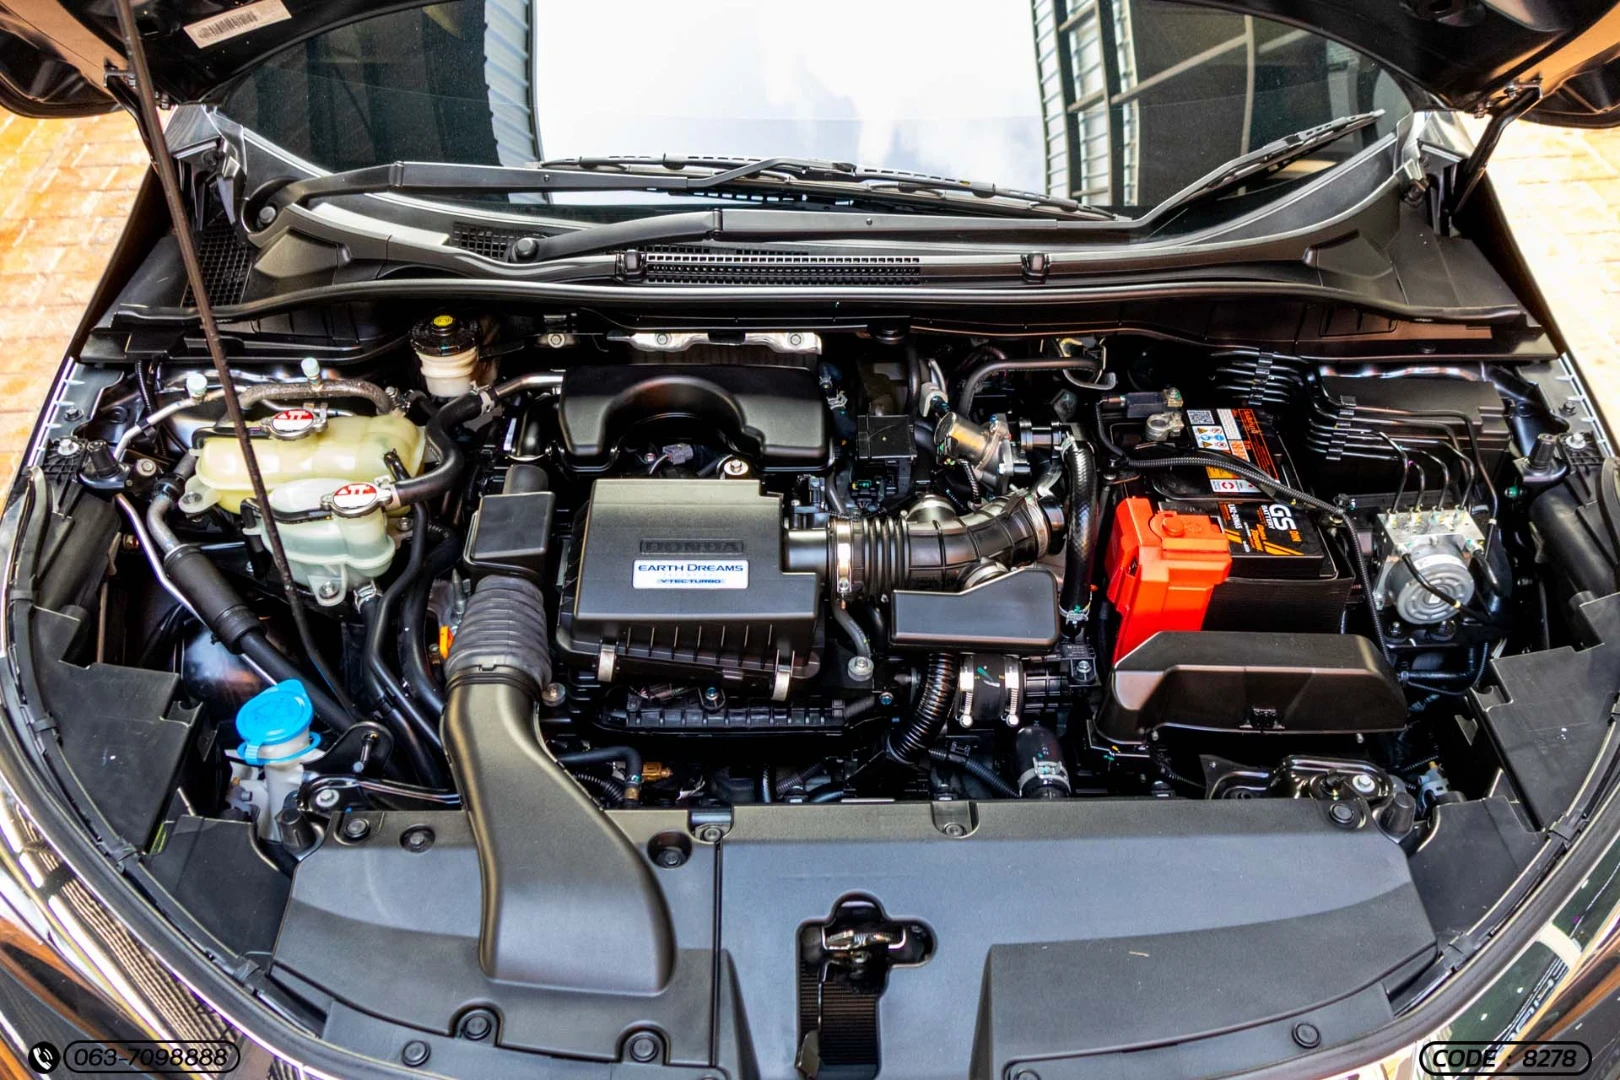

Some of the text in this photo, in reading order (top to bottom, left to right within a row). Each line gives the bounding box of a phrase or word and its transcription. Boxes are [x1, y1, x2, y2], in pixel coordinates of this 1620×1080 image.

[1261, 504, 1276, 530] BATTERY
[1269, 504, 1297, 531] GS
[638, 563, 744, 572] EARTH DREAMS
